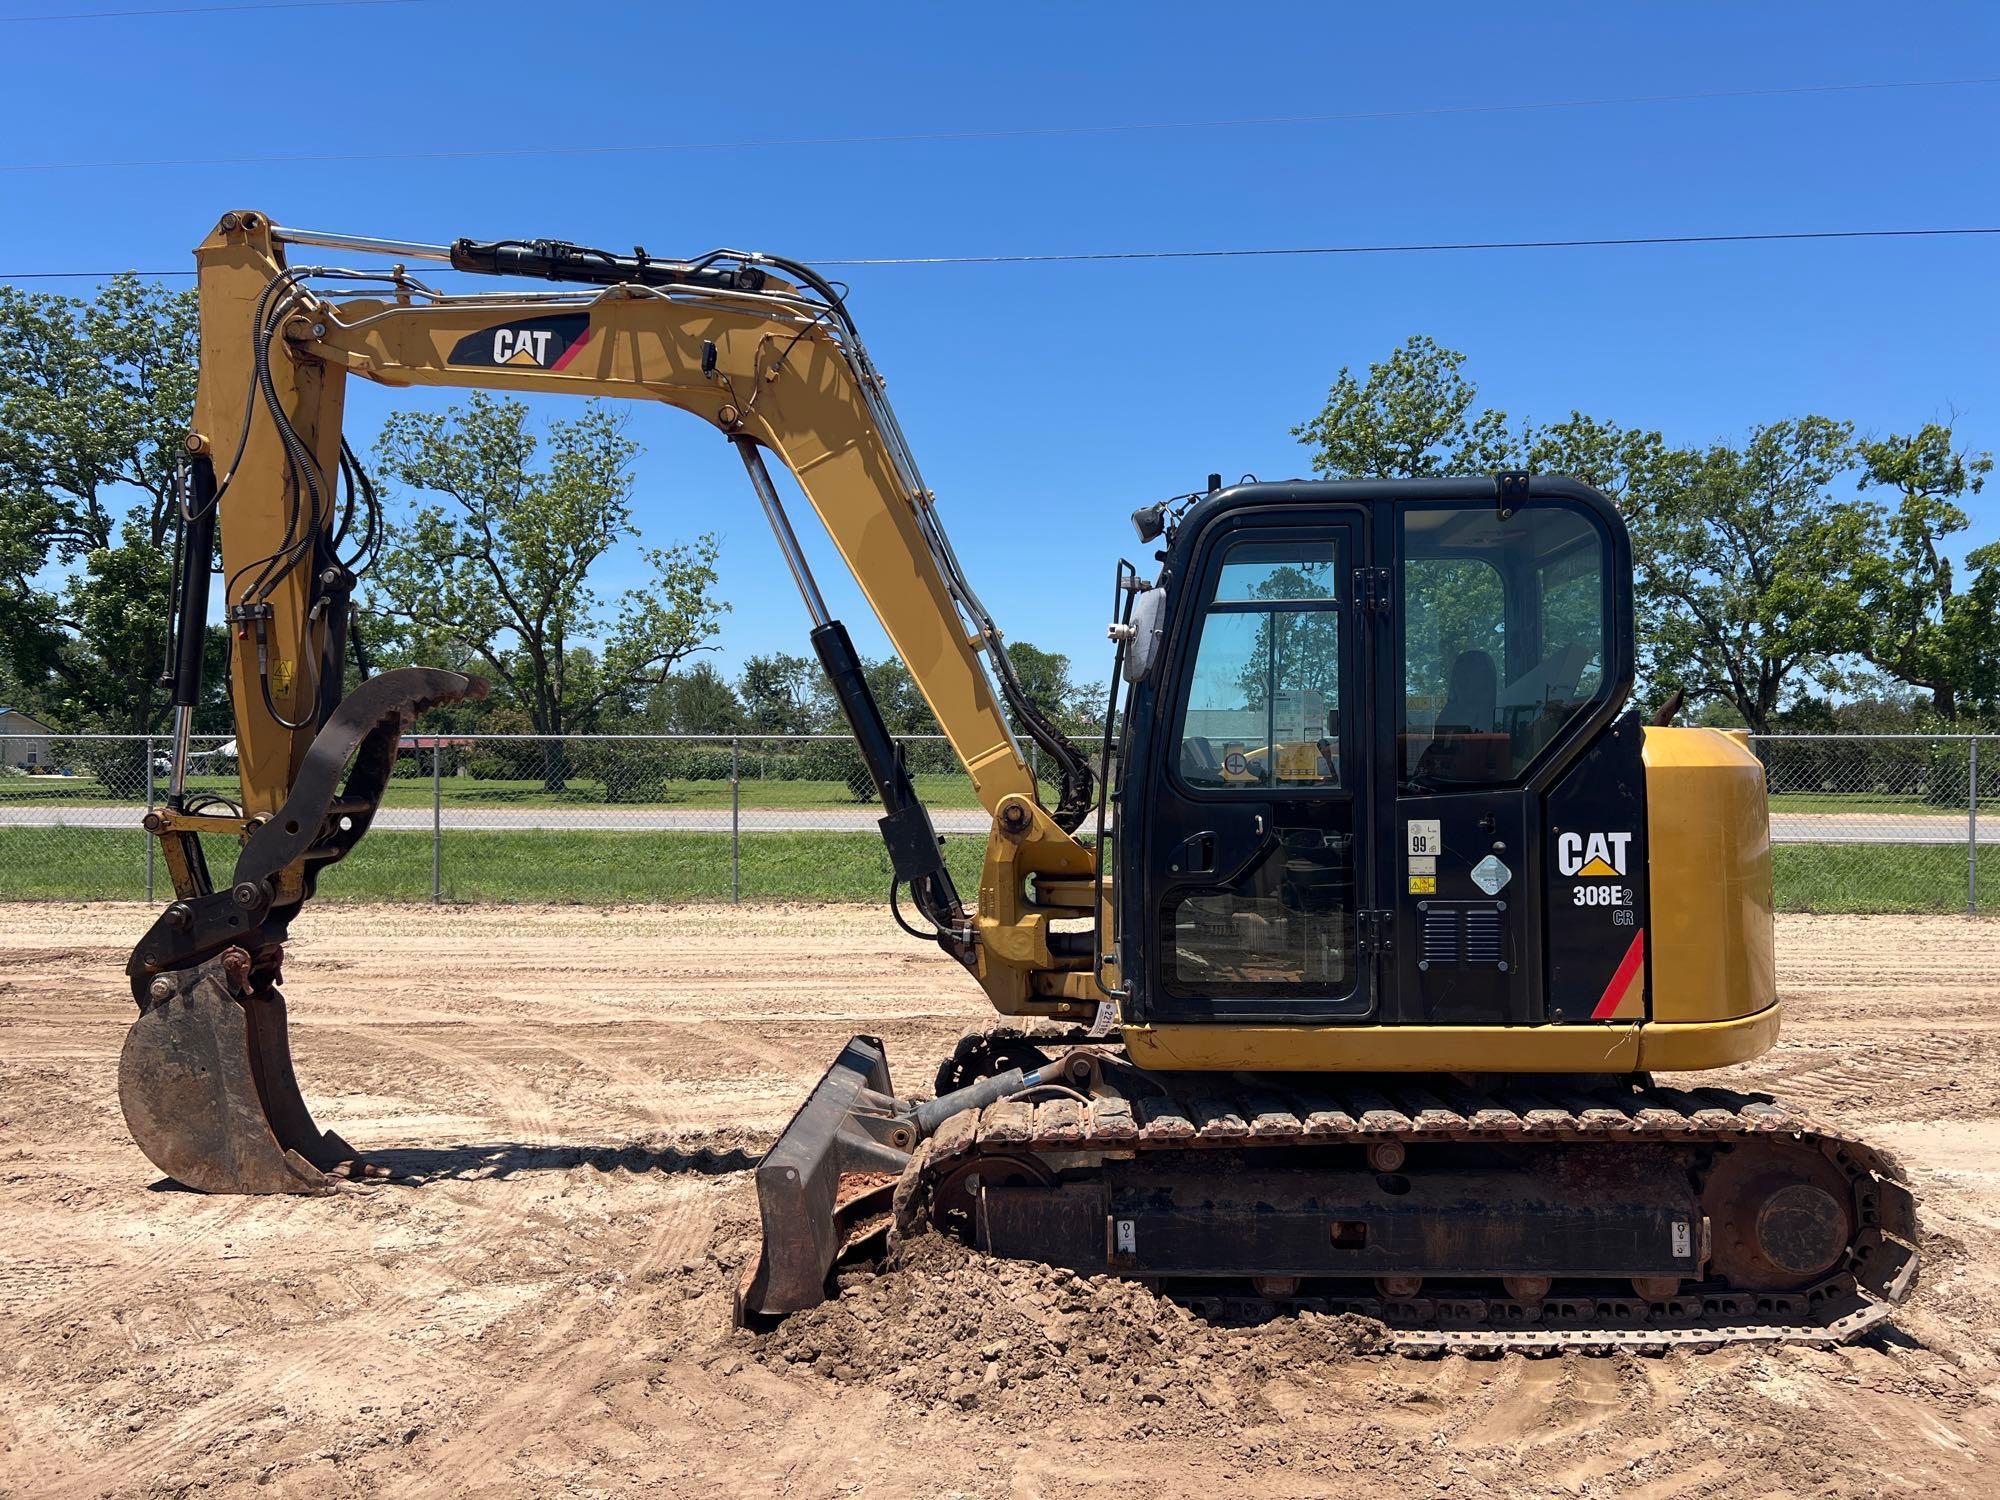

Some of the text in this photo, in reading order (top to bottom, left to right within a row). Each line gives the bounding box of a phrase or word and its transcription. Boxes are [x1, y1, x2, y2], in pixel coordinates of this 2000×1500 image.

[493, 328, 552, 366] CAT
[1412, 835, 1427, 853] 99
[1558, 832, 1632, 877] CAT
[1573, 885, 1633, 906] 308E2
[1612, 909, 1634, 926] CR
